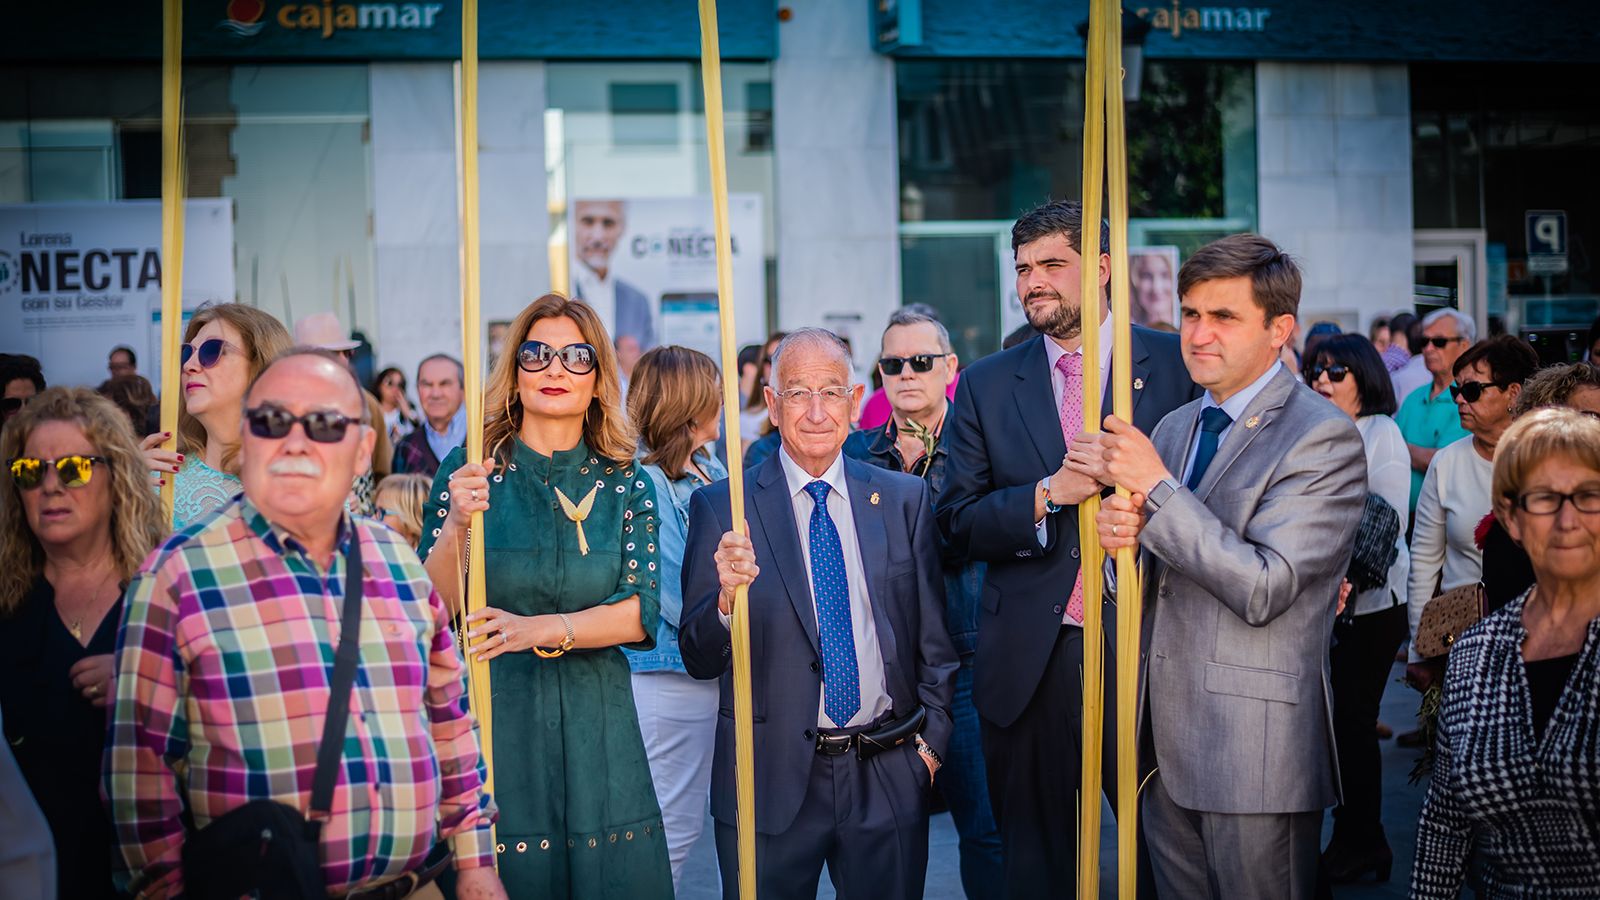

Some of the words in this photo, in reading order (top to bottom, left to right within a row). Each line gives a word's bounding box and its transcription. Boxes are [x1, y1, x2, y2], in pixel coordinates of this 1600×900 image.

[277, 0, 442, 39] cajamar
[20, 231, 73, 247] Lorena
[631, 235, 739, 258] CNEC
[22, 299, 50, 312] con
[54, 298, 72, 311] su
[76, 295, 125, 311] Gestor
